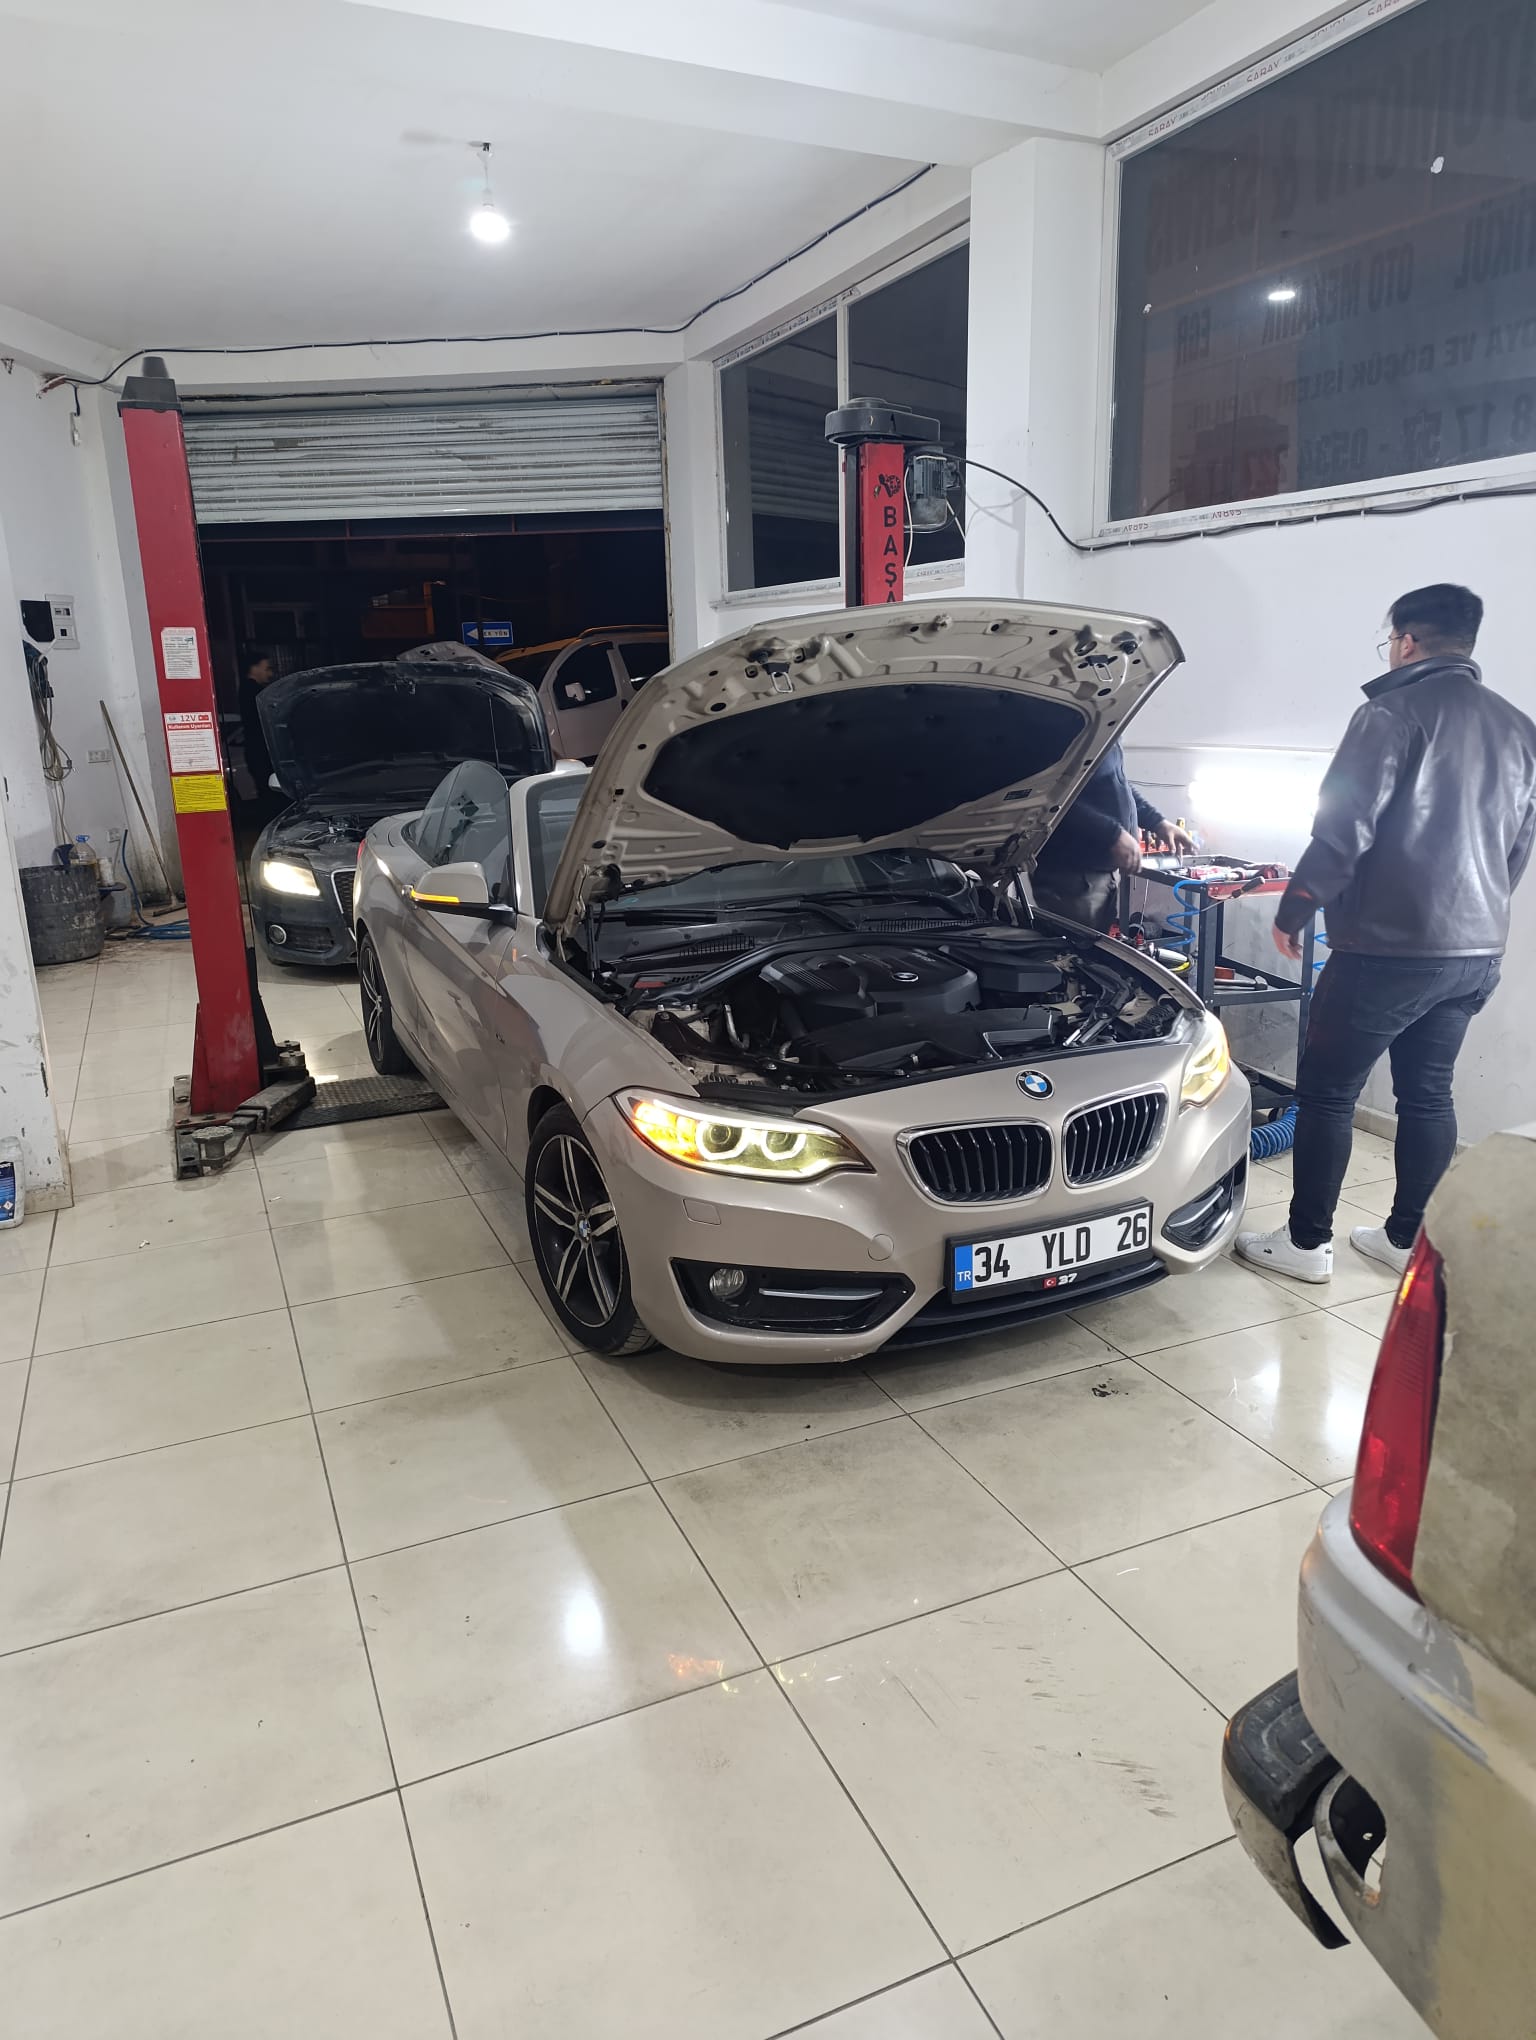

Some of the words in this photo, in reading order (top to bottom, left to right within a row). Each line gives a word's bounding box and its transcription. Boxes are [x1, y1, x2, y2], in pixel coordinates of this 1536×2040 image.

[180, 714, 196, 722] 12V
[957, 1271, 971, 1282] TR
[974, 1243, 1010, 1283] 34
[1042, 1226, 1091, 1270] YLD
[1117, 1212, 1147, 1252] 26
